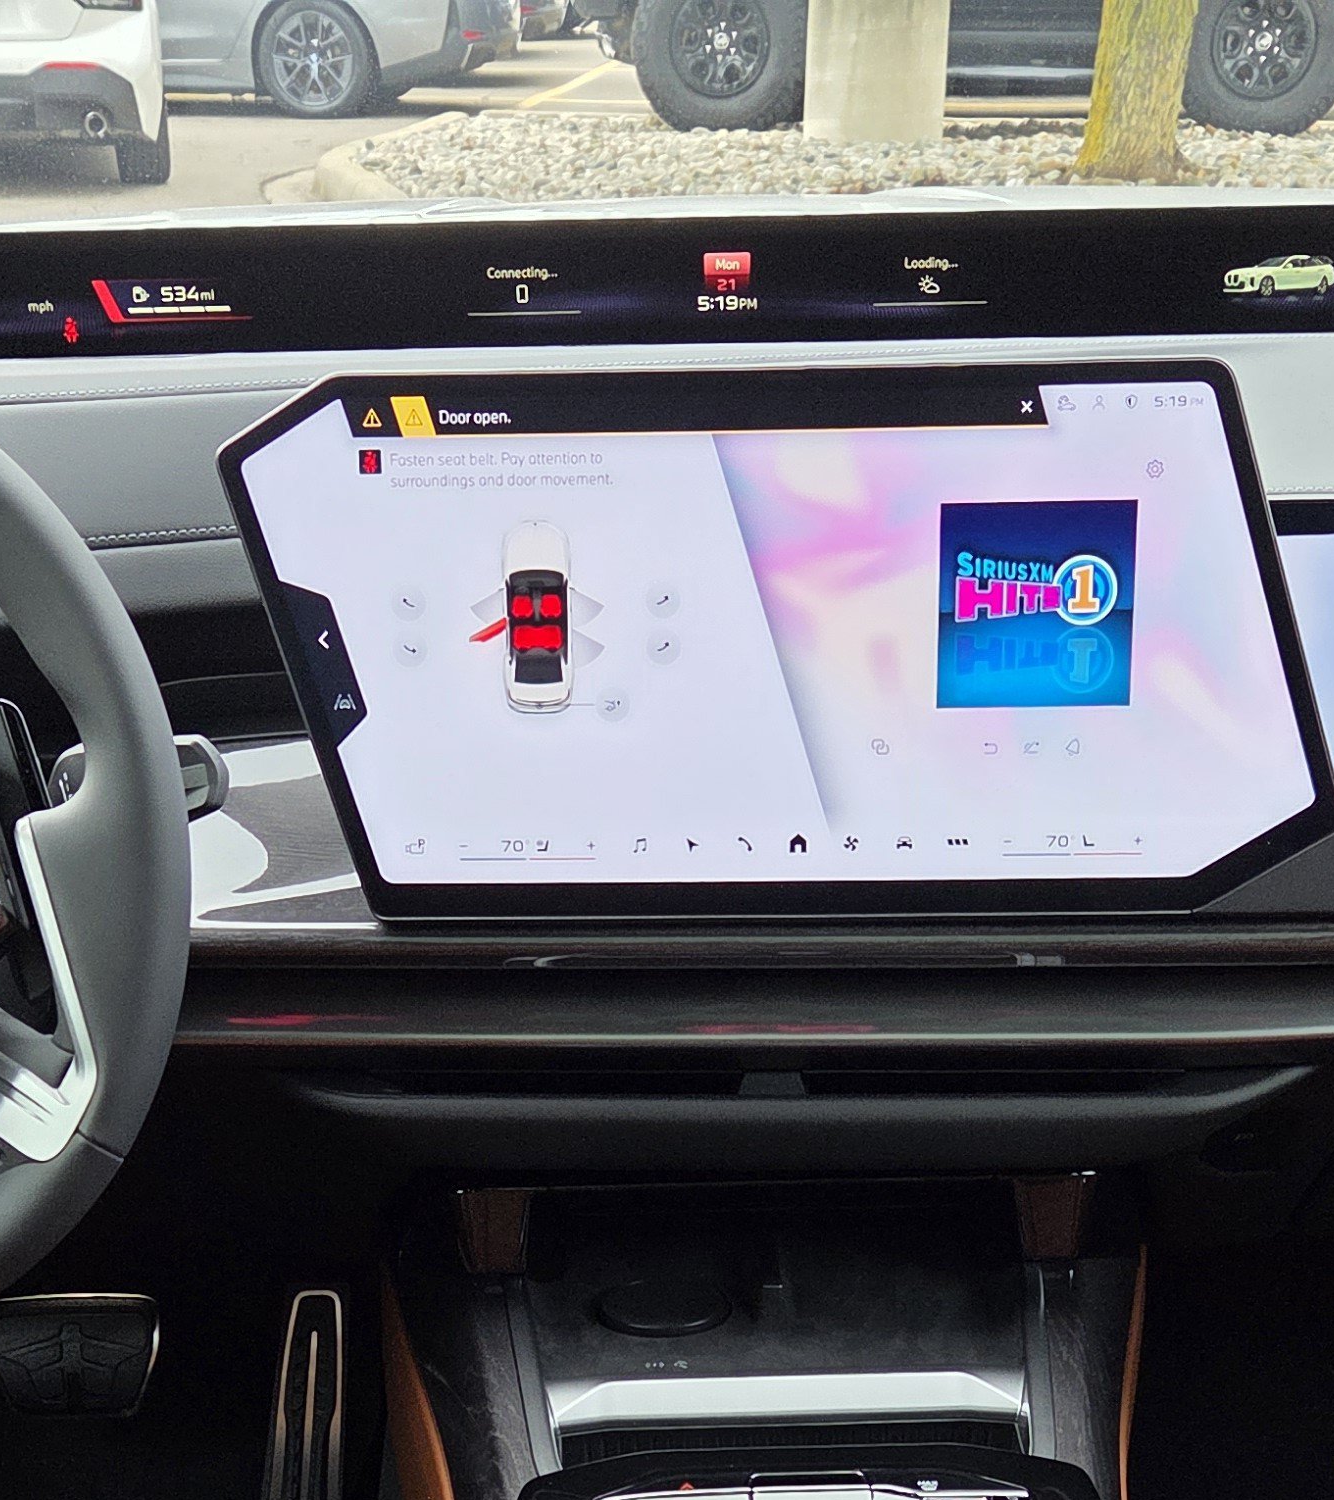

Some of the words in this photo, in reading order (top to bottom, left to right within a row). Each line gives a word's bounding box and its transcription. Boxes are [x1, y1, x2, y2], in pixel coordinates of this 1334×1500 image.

[715, 258, 740, 271] Mon
[903, 256, 959, 272] Loading...
[486, 266, 559, 282] Connecting...
[717, 279, 736, 291] 21
[27, 300, 54, 315] mph
[438, 409, 471, 425] Door
[473, 411, 512, 427] open.
[390, 453, 434, 467] Fasten
[437, 454, 465, 466] seat
[469, 452, 497, 466] belt.
[501, 452, 526, 467] Pay
[528, 452, 586, 465] attention
[589, 452, 603, 464] to
[390, 474, 475, 490] surroundings
[478, 474, 504, 487] and
[507, 473, 537, 487] door
[540, 473, 614, 487] movement.
